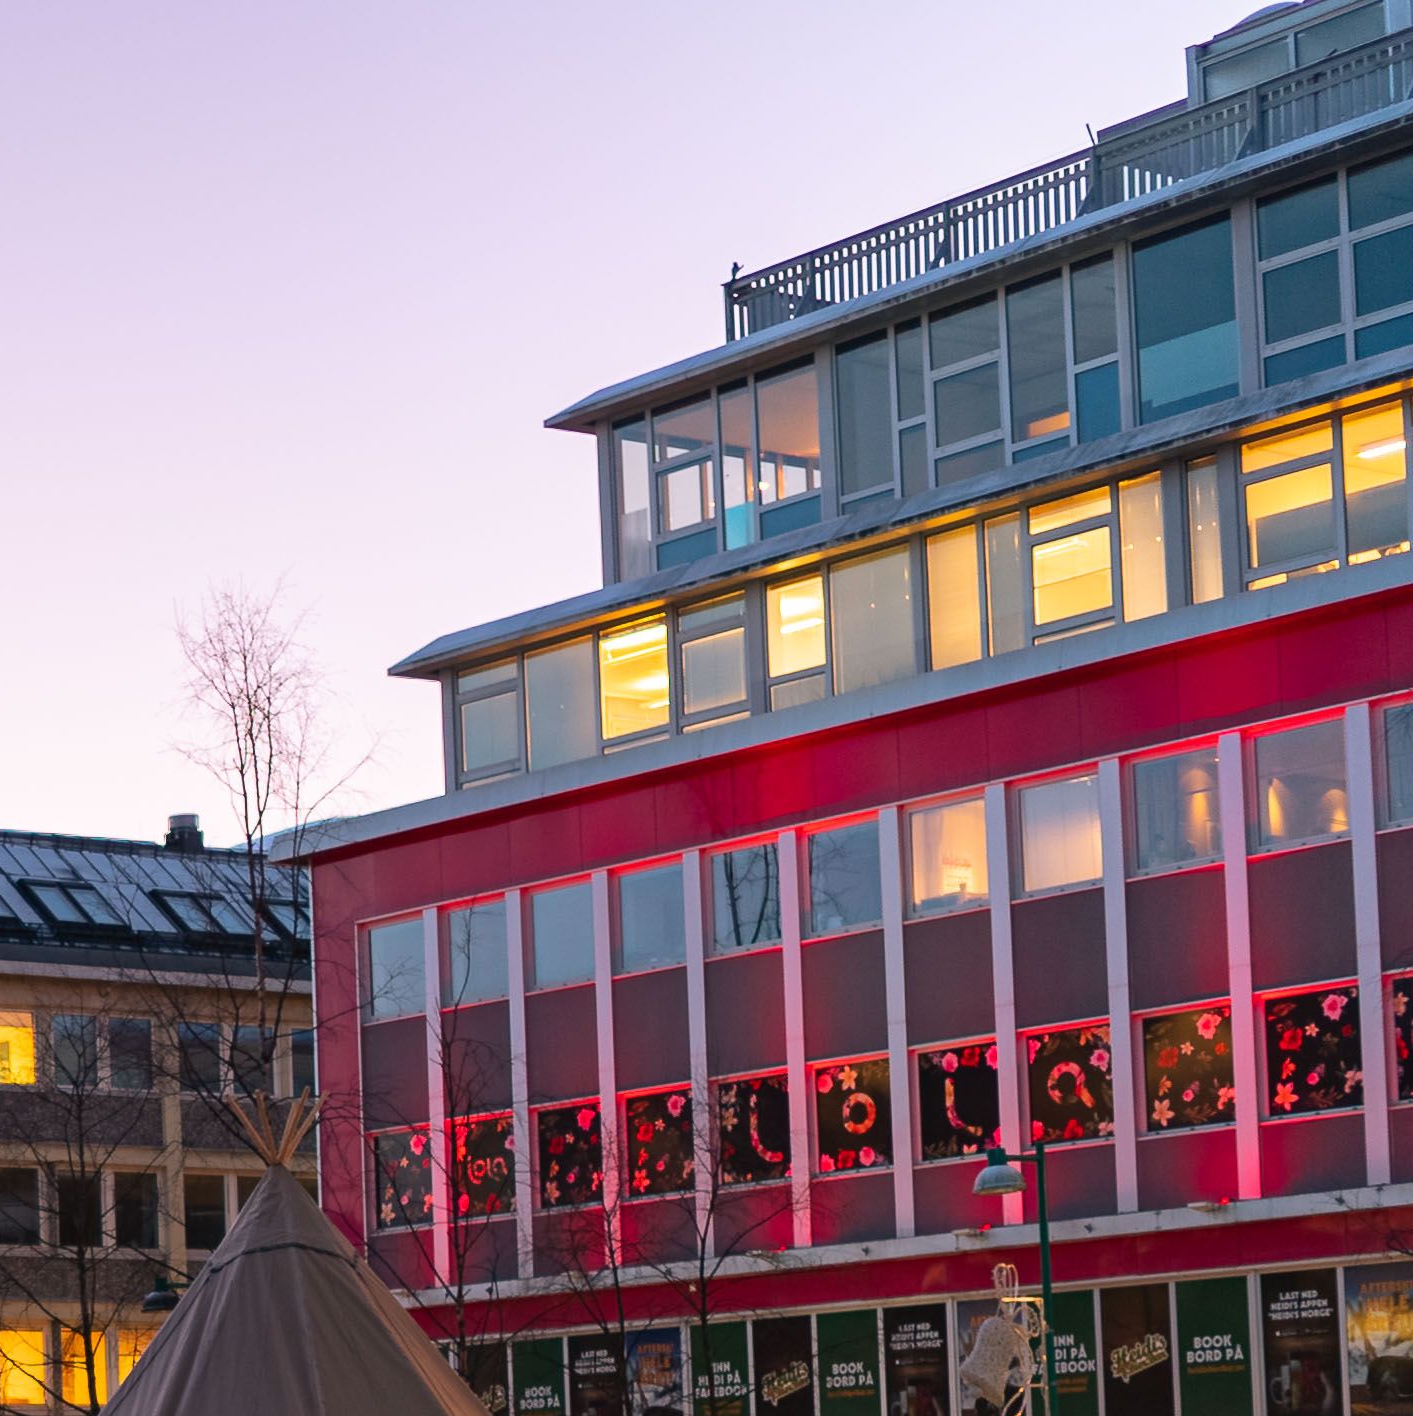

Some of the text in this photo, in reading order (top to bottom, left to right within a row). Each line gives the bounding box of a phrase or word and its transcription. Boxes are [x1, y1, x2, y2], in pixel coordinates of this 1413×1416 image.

[1053, 1334, 1075, 1346] INN
[1193, 1334, 1233, 1348] BOOK
[1186, 1344, 1244, 1364] BORD PÅ
[713, 1361, 731, 1373] INN
[832, 1361, 864, 1375] BOOK
[859, 1370, 874, 1386] PÅ
